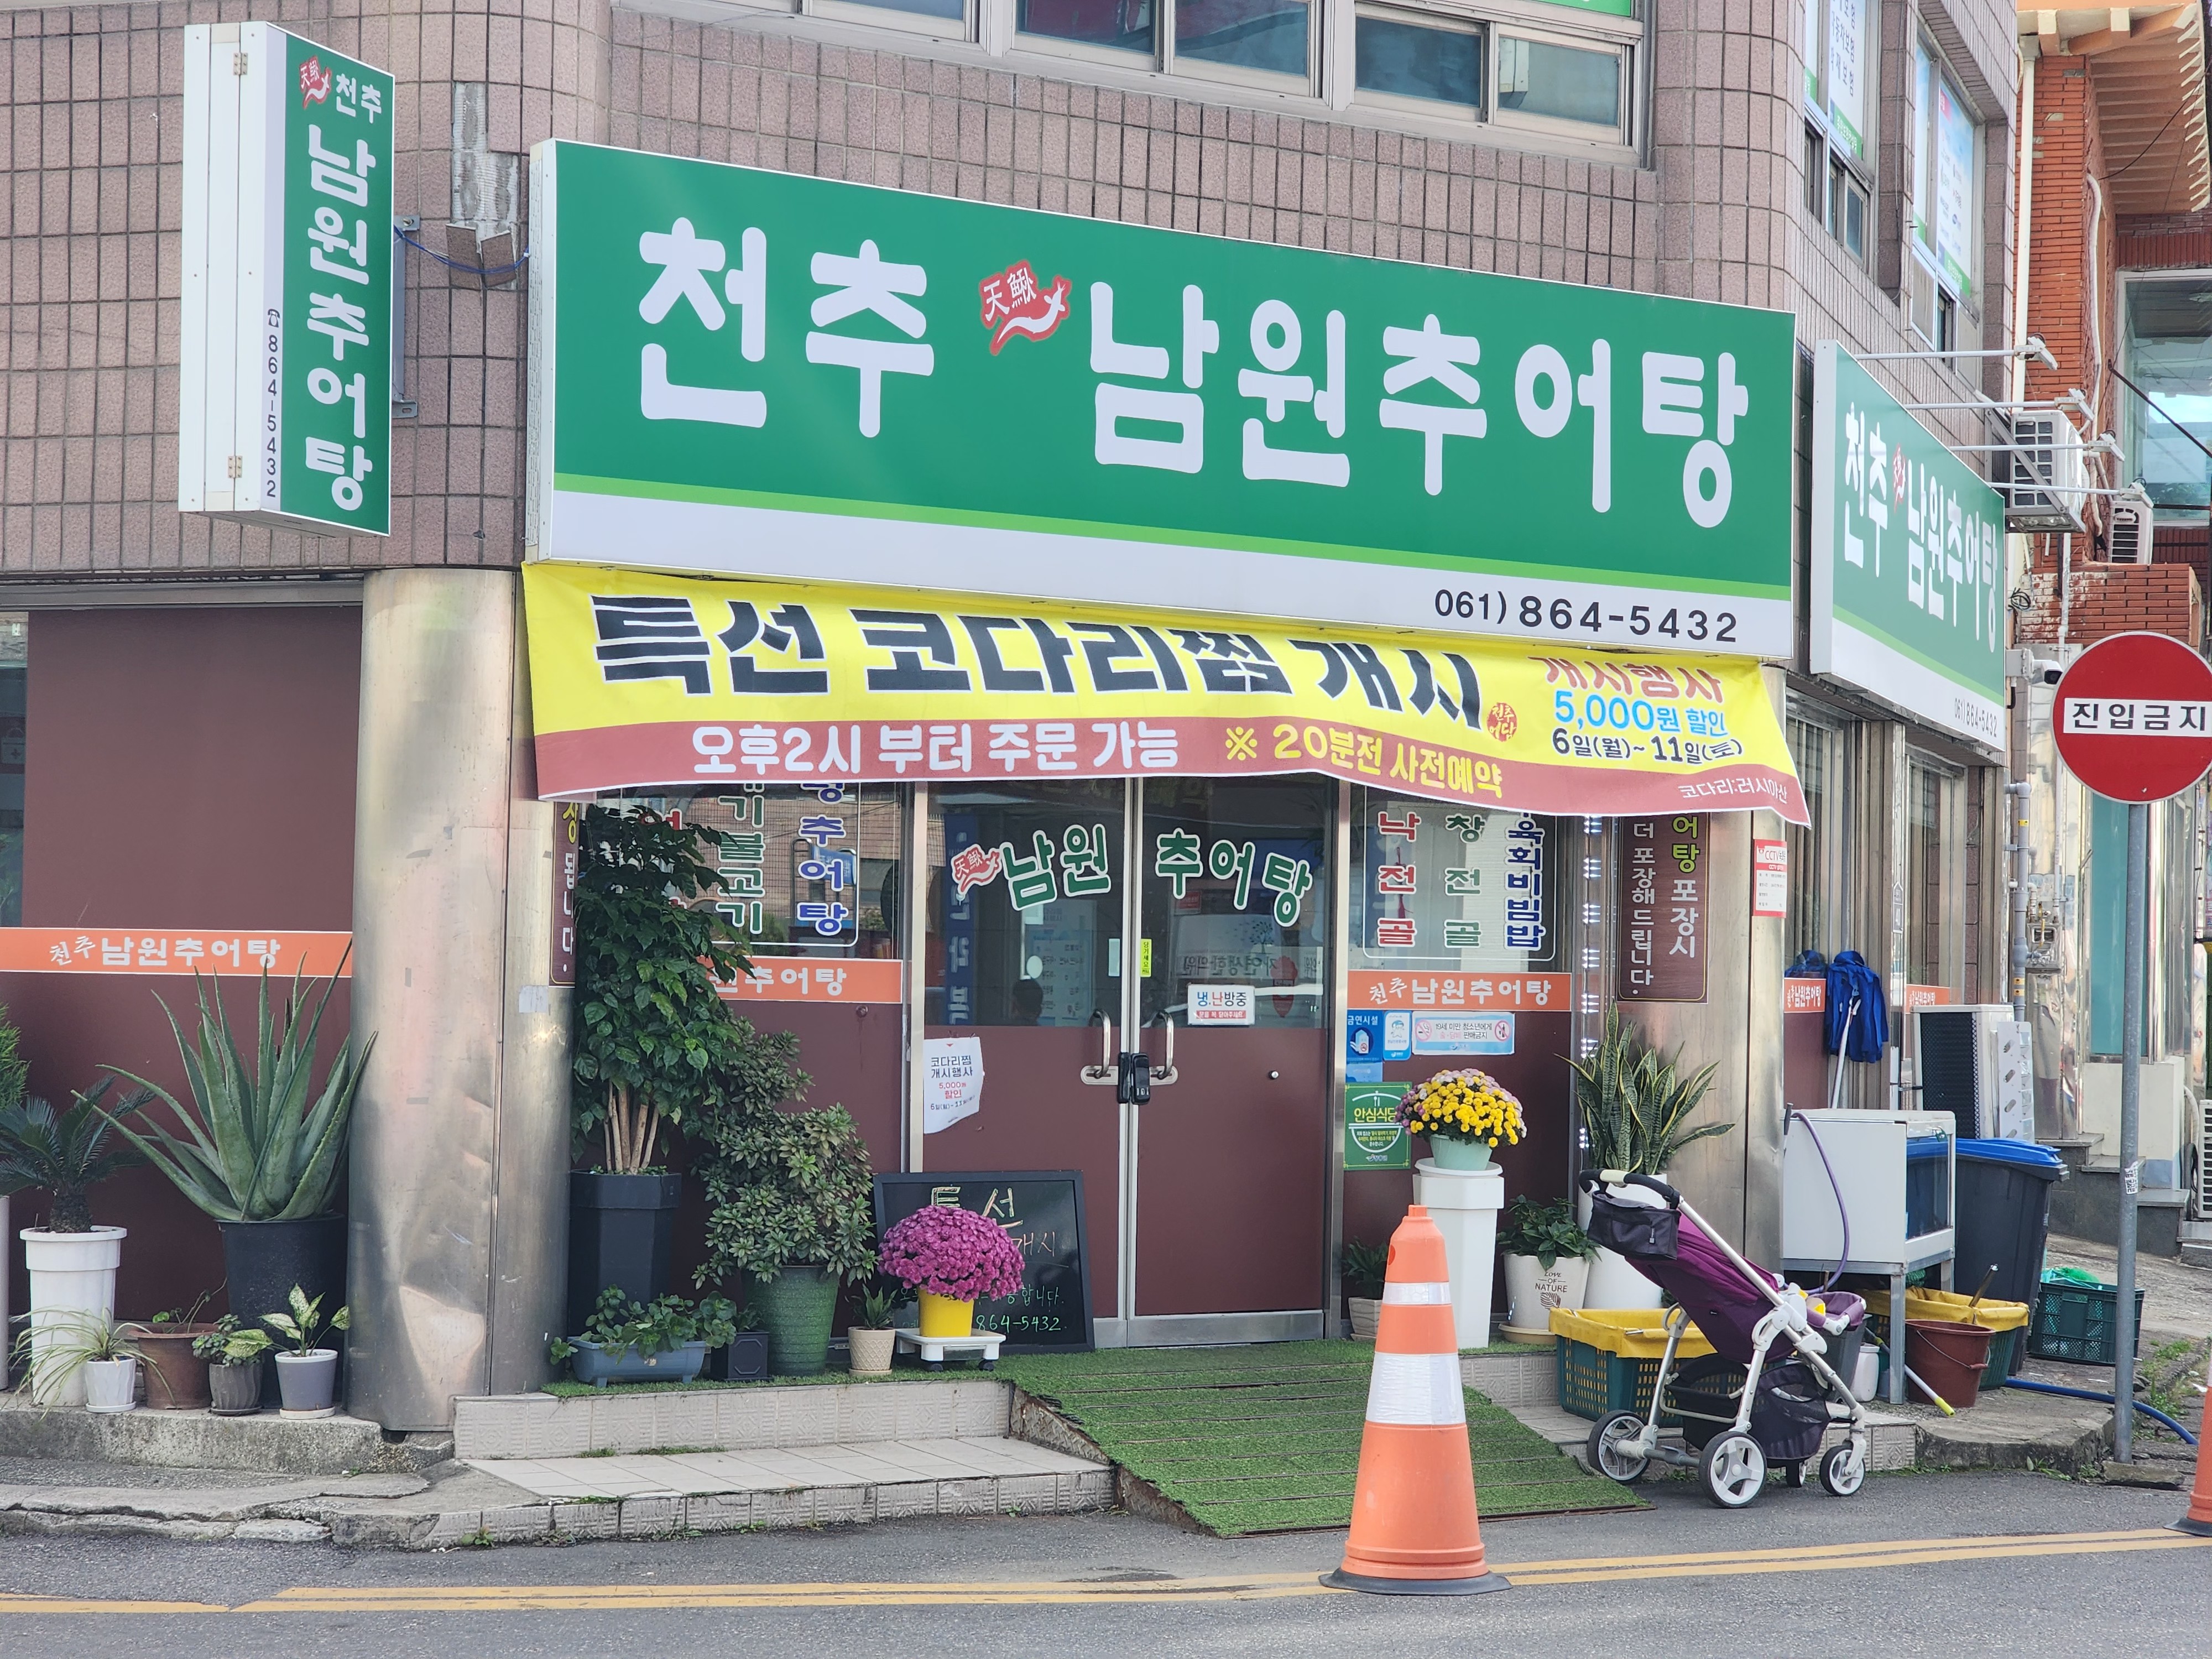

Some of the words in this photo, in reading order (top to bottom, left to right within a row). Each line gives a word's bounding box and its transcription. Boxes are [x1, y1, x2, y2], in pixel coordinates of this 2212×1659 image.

[335, 72, 382, 123] 천추
[305, 123, 376, 512] 남원추어탕
[639, 217, 935, 439] 천추
[267, 335, 279, 498] 864-5432
[1090, 281, 1749, 528] 남원추어탕
[1844, 402, 1887, 578] 천추
[1908, 459, 1998, 654] 남원추어탕
[1436, 588, 1507, 624] 061)
[1520, 596, 1738, 643] 864-5432
[589, 594, 828, 694] 특선
[850, 608, 1293, 693] 코다리찜
[1294, 642, 1483, 727] 개시
[1527, 656, 1723, 704] 개시행사
[1555, 690, 1681, 732] 5,000원
[1686, 708, 1728, 737] 할인
[1955, 697, 1965, 723] 061)
[1966, 702, 1997, 738] 864-5432
[2072, 703, 2206, 731] 진입금지
[692, 724, 860, 775] 오후2시
[879, 723, 972, 774] 부터
[988, 722, 1077, 773] 주문
[1092, 721, 1179, 770] 가능
[1273, 724, 1383, 774] 20분전
[1389, 738, 1504, 798] 사전예약
[717, 783, 765, 933] 기불고기
[1001, 823, 1110, 911] 남원
[1155, 828, 1312, 926] 추어탕
[1504, 812, 1546, 951] 육회비빔밥
[1631, 848, 1656, 905] 포장해
[1669, 879, 1699, 958] 포장시
[49, 936, 96, 966] 천추
[101, 937, 281, 968] 남원추어탕
[1369, 977, 1407, 1004] 천추
[1412, 978, 1551, 1005] 남원추어탕
[1348, 1015, 1378, 1025] 금연시설
[931, 1055, 972, 1067] 코다리찜
[931, 1066, 973, 1078] 개시행사
[945, 1089, 962, 1099] 할인
[1354, 1108, 1397, 1122] 안심식당
[1535, 1283, 1568, 1293] NATURE
[975, 1314, 1062, 1333] 864-5432
